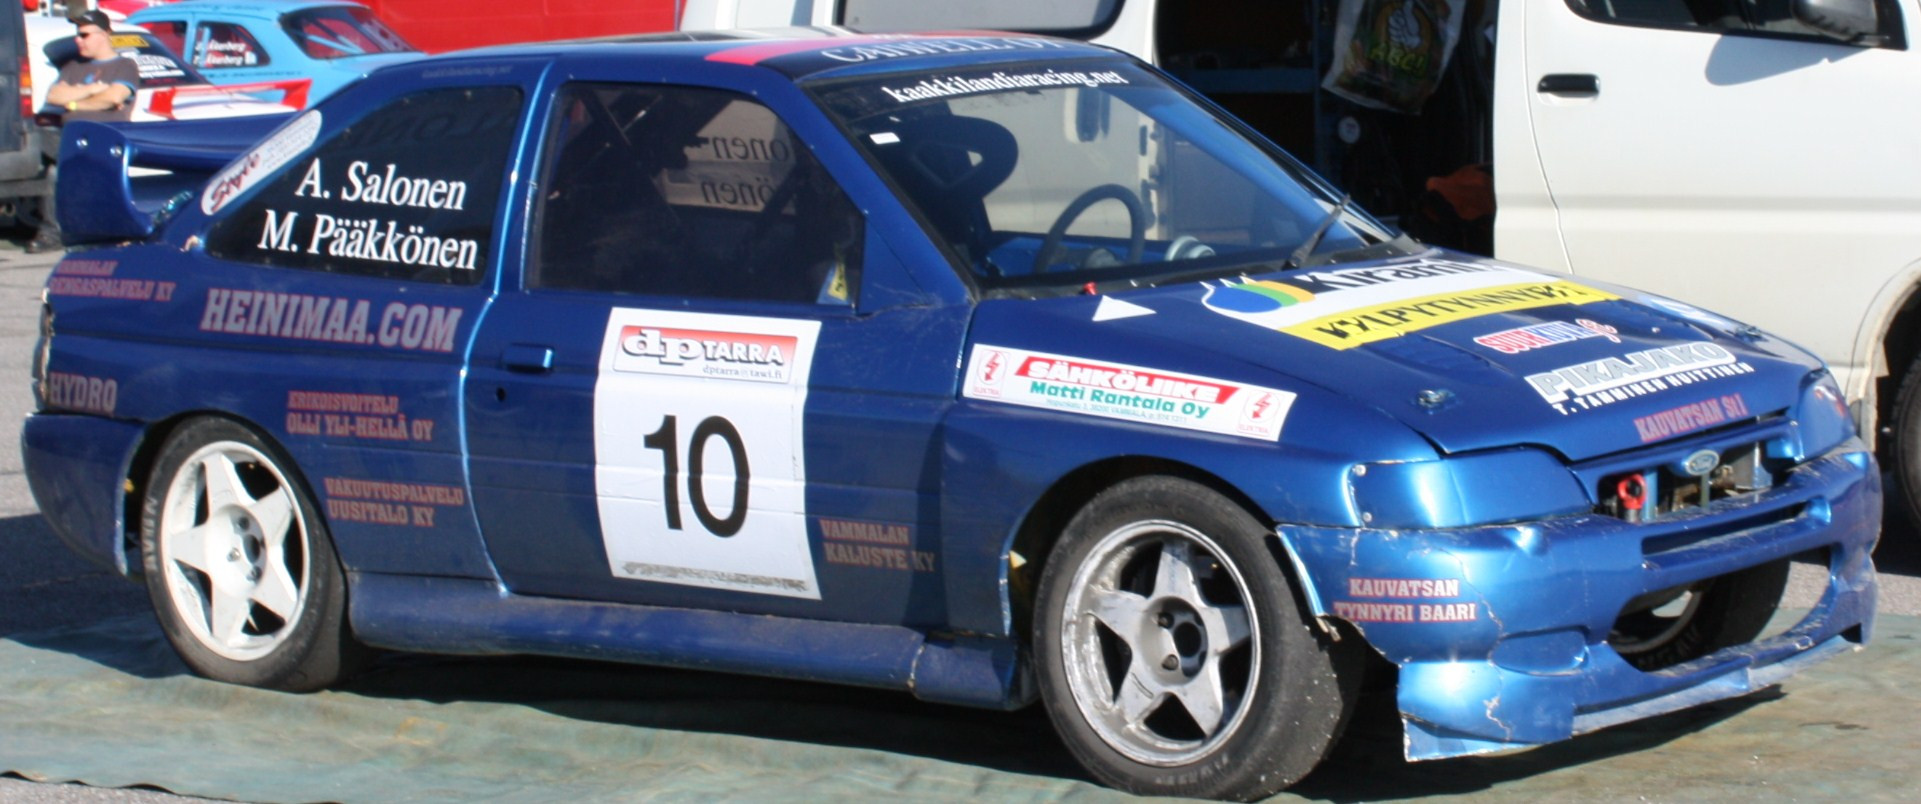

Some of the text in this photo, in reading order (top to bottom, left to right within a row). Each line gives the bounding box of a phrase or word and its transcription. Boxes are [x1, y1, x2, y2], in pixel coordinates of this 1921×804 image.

[882, 69, 1129, 103] kaakkilandiaracing.net
[295, 157, 467, 210] A. Salonen
[257, 209, 478, 270] M. Pääkkönen
[199, 287, 463, 352] HEINIMAA.COM
[1027, 359, 1220, 404] SÄHKÖLIIKE
[1526, 341, 1735, 401] PIKAJAKO
[1552, 362, 1755, 416] T. TAMMINEN HUITTINEN
[49, 371, 117, 417] HYDRO
[1030, 381, 1085, 400] Matti
[1090, 389, 1175, 413] Rantala
[1181, 401, 1211, 419] Oy
[286, 412, 434, 441] OLLI YLI-HELLÄ OY
[1633, 398, 1725, 442] KAUVATSAN
[324, 477, 465, 506] VAKUUTUSPALVELU
[643, 415, 751, 538] 10
[328, 498, 435, 527] UUSITALO KY
[819, 517, 911, 545] VAMMALAN
[823, 542, 935, 572] KALUSTE KY
[1349, 578, 1459, 598] KAUVATSAN
[1333, 602, 1476, 622] TYNNYRI BAARI
